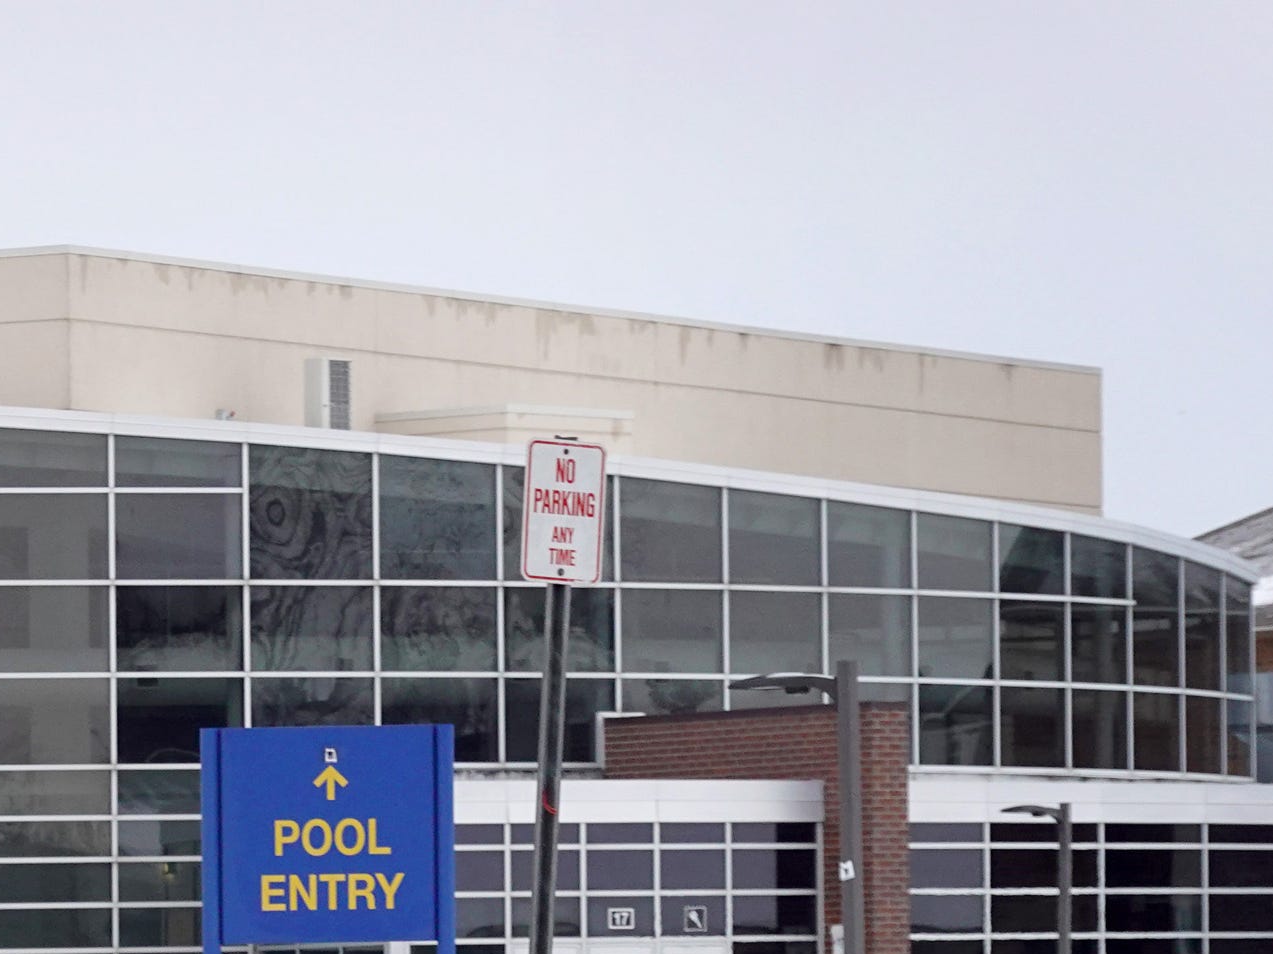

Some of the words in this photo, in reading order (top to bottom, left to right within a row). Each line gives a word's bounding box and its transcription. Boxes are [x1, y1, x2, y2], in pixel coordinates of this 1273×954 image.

[556, 458, 575, 484] NO
[533, 488, 595, 518] PARKING
[551, 526, 574, 544] ANY
[548, 547, 576, 566] TIME
[273, 818, 391, 857] POOL
[260, 872, 405, 911] ENTRY
[612, 912, 628, 926] 17
